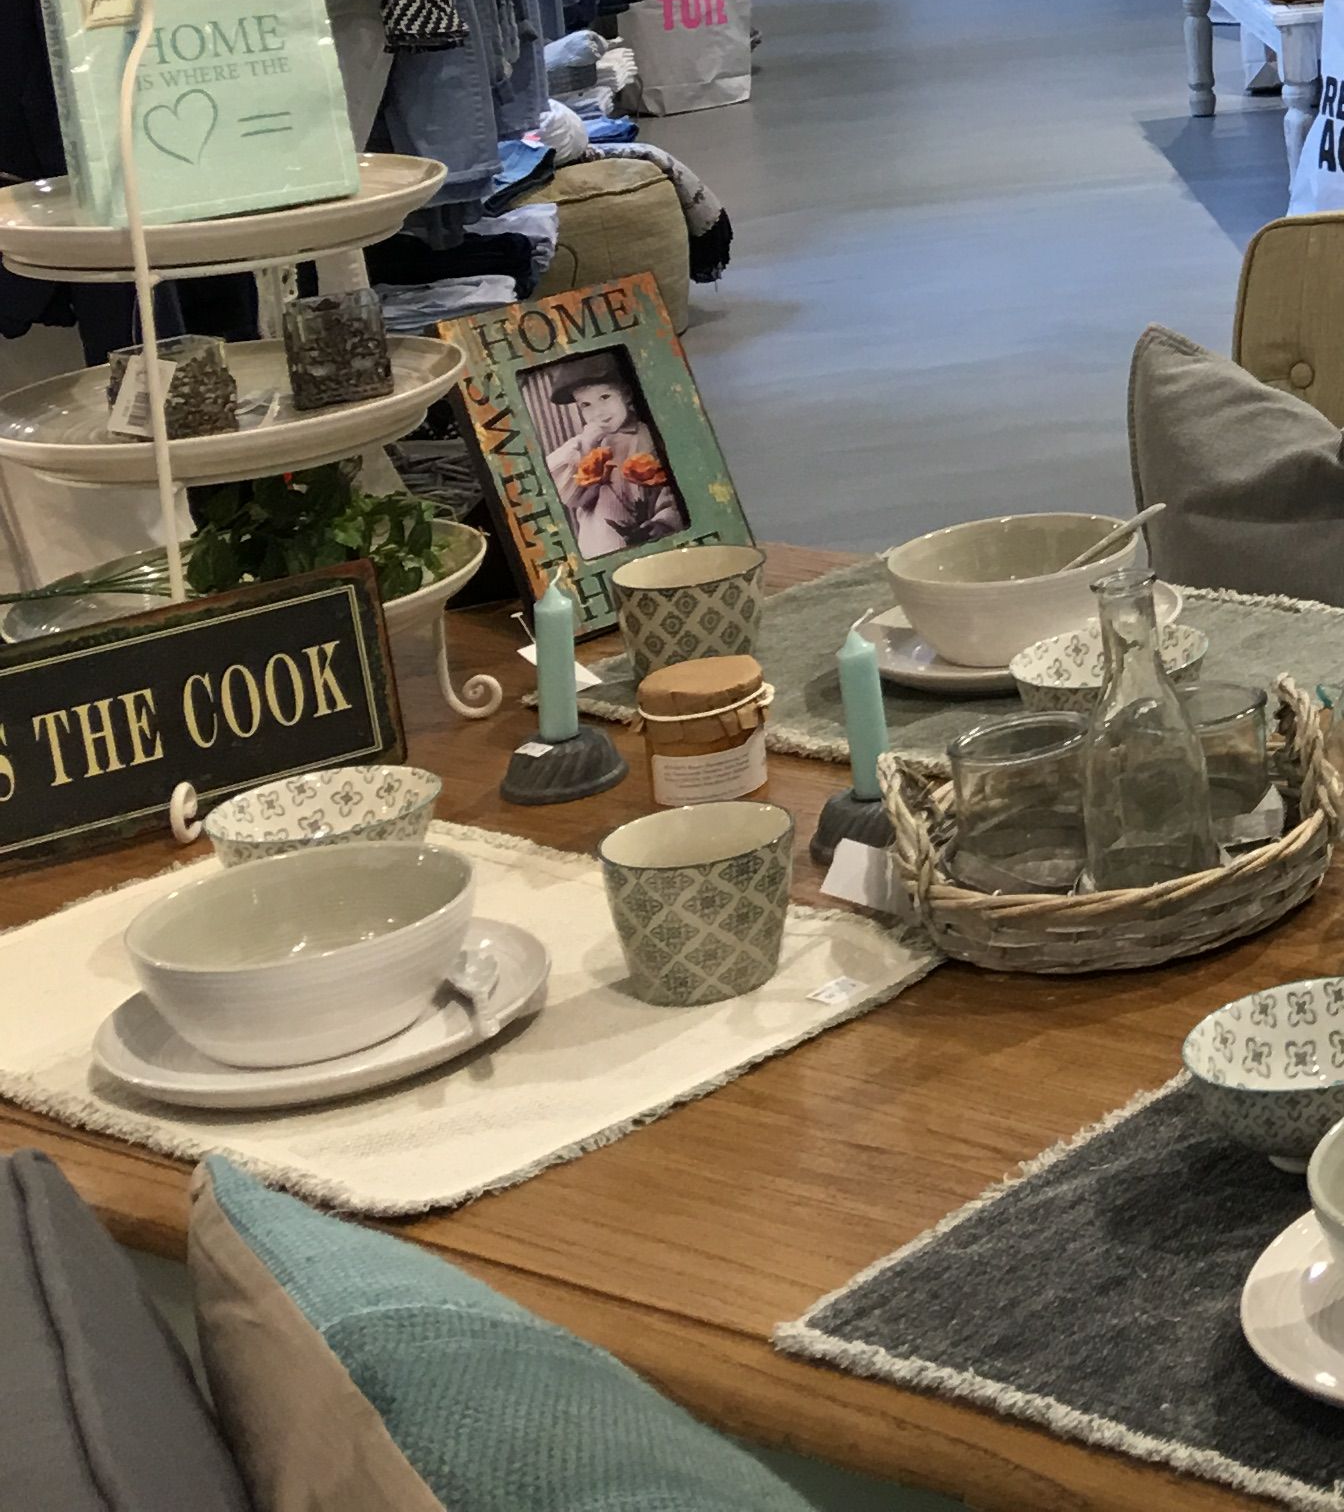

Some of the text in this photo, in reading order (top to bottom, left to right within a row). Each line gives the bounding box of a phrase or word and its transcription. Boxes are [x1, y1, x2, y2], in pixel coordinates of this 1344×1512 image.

[126, 14, 286, 67] HOME
[159, 62, 241, 89] WHERE
[244, 56, 292, 76] THE
[472, 287, 641, 366] HOME
[465, 372, 573, 580] SWEET
[32, 688, 164, 787] THE
[183, 640, 353, 750] COOK
